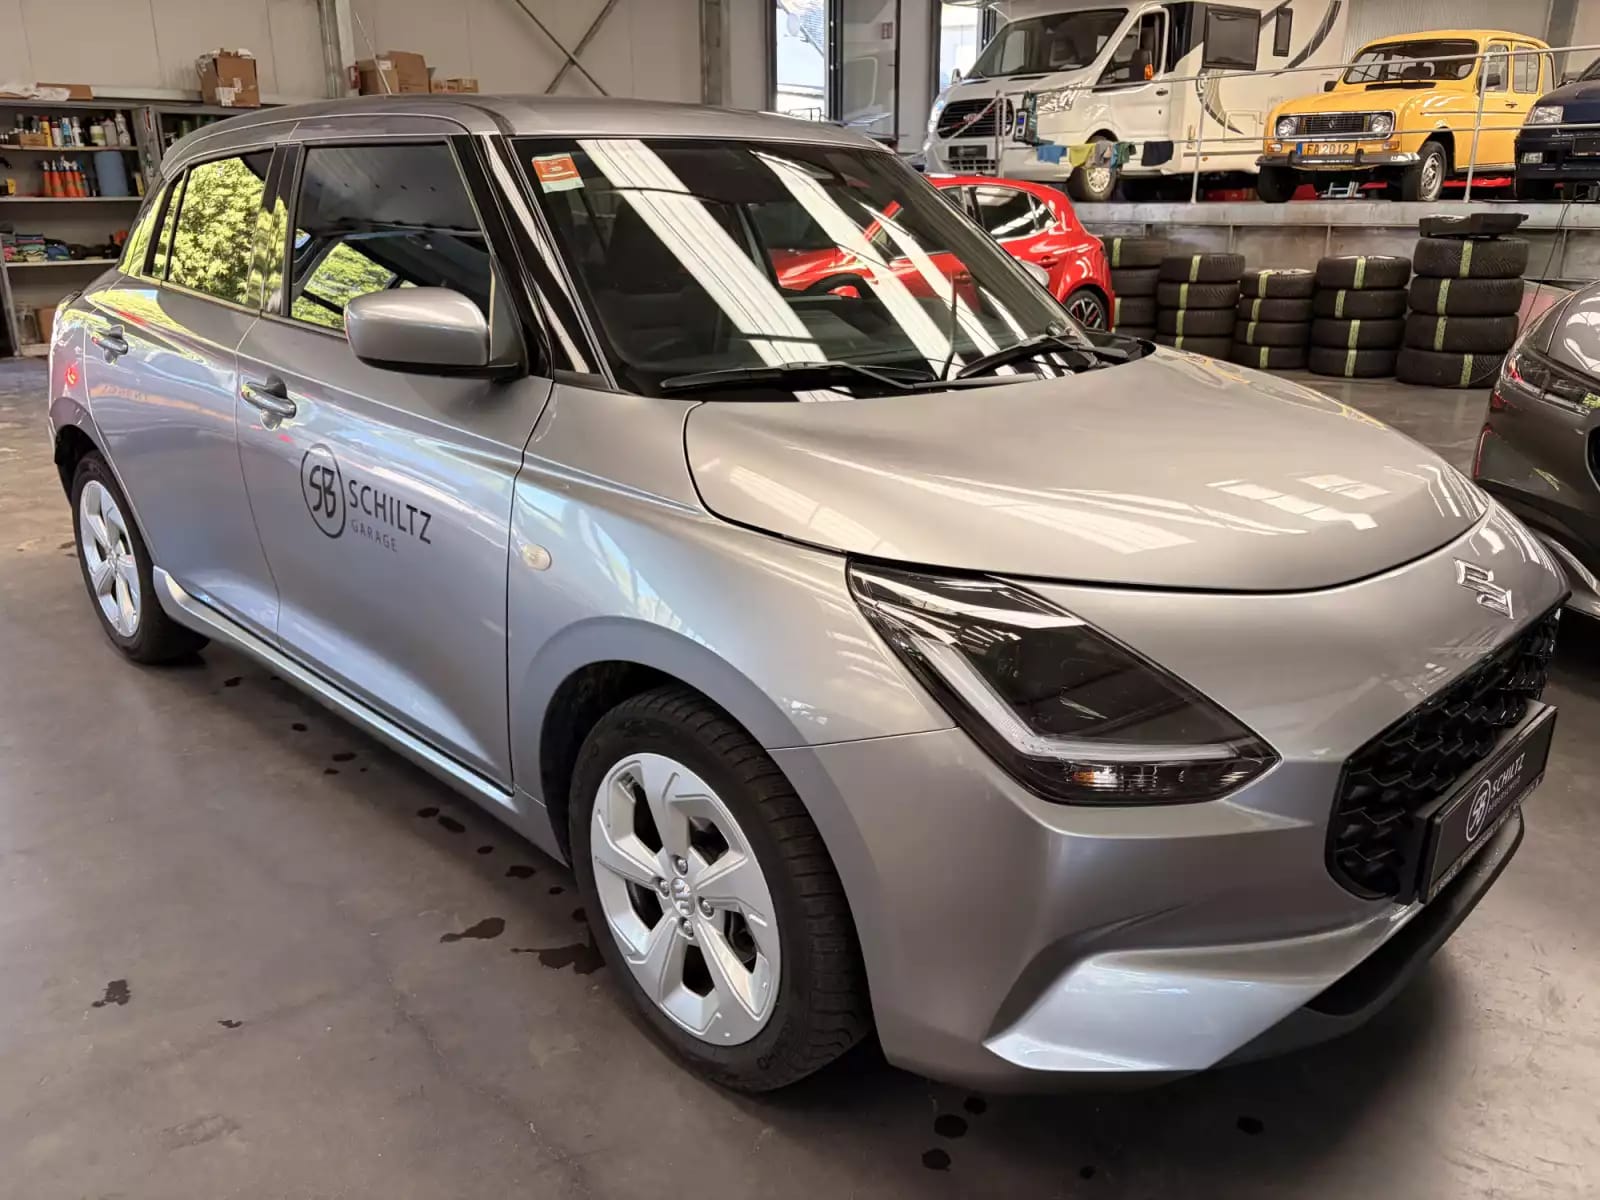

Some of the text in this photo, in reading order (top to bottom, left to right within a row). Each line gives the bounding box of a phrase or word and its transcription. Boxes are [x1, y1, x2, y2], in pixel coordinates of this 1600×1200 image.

[348, 479, 432, 545] SCHILTZ
[351, 519, 398, 553] GARAGE
[1490, 752, 1526, 799] SCHILTZ
